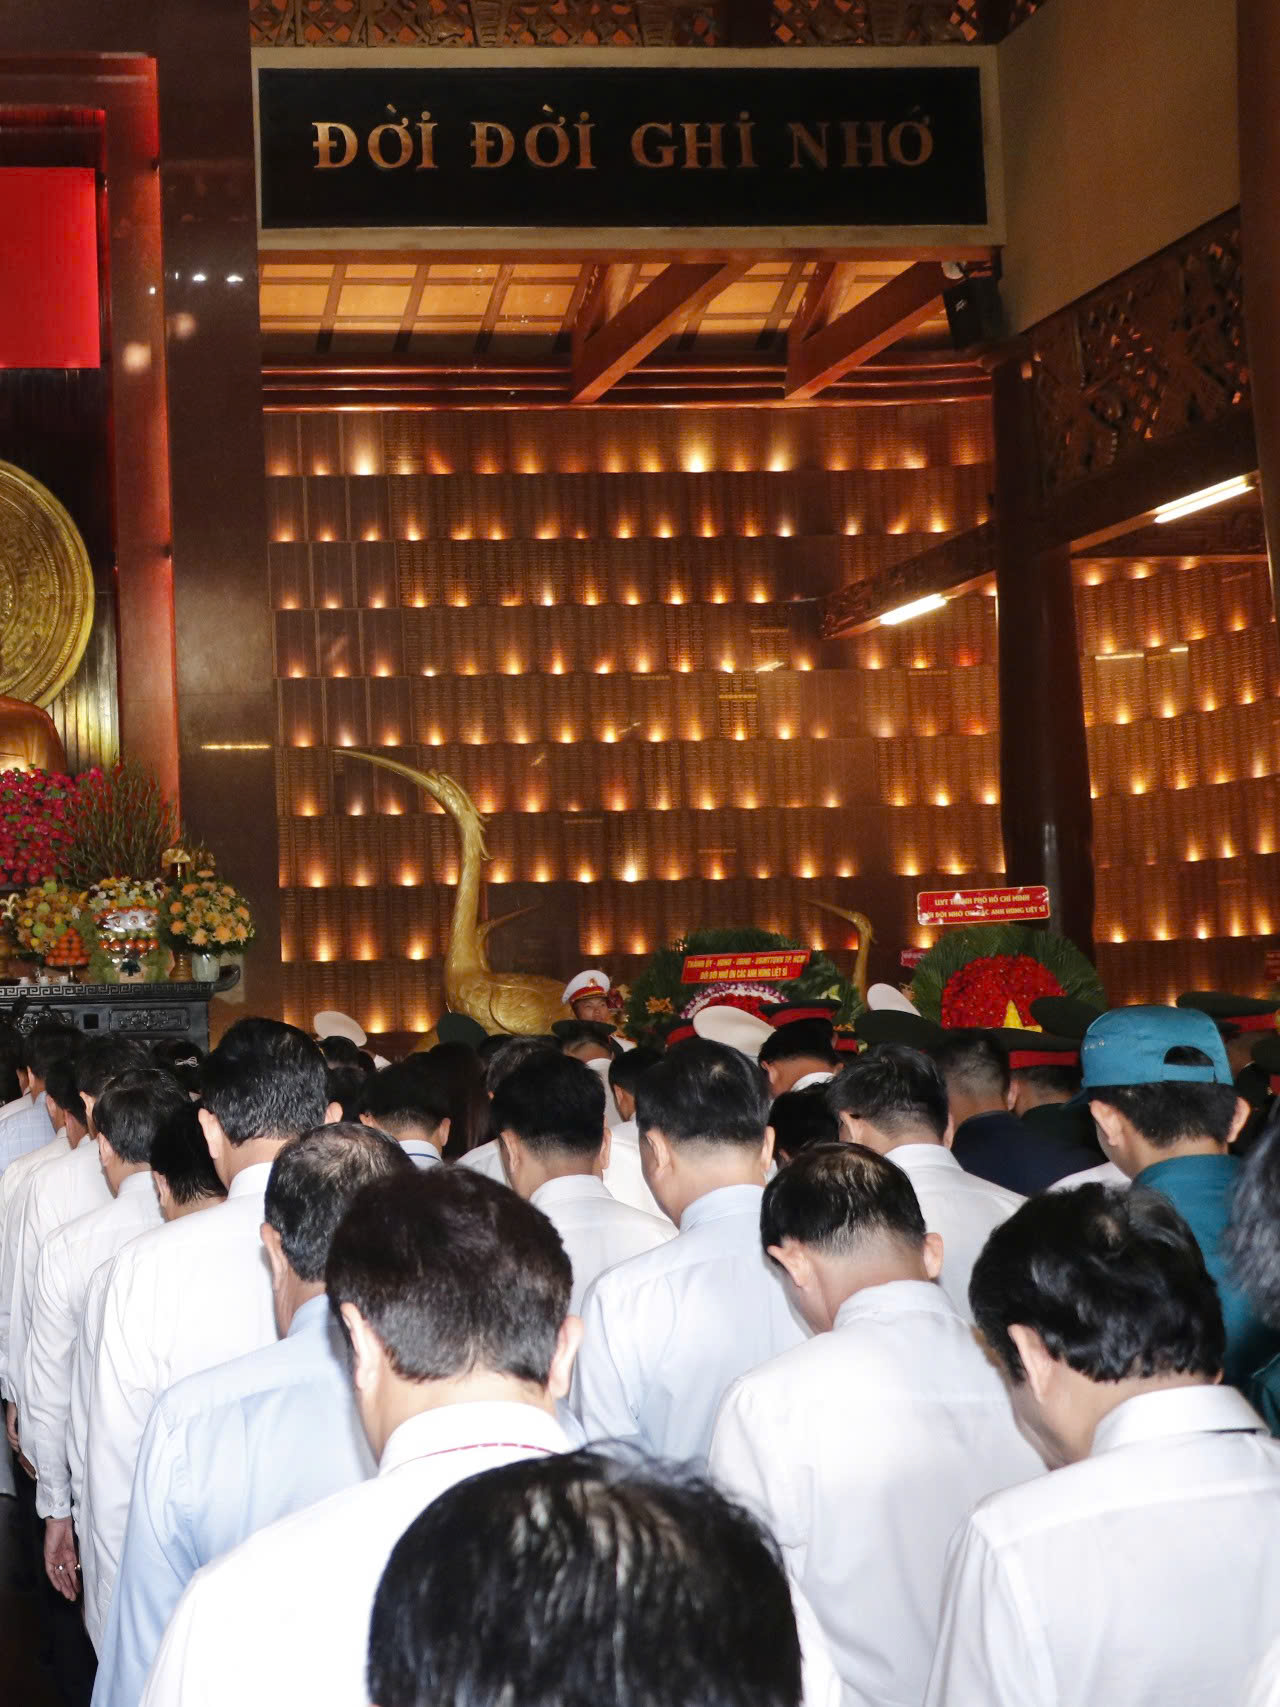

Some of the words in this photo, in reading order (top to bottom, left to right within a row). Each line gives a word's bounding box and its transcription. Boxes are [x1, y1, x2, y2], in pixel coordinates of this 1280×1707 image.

[311, 103, 439, 169] ĐỜI
[470, 104, 596, 169] ĐỜI
[630, 110, 758, 169] GHI
[787, 105, 934, 169] NHỚ
